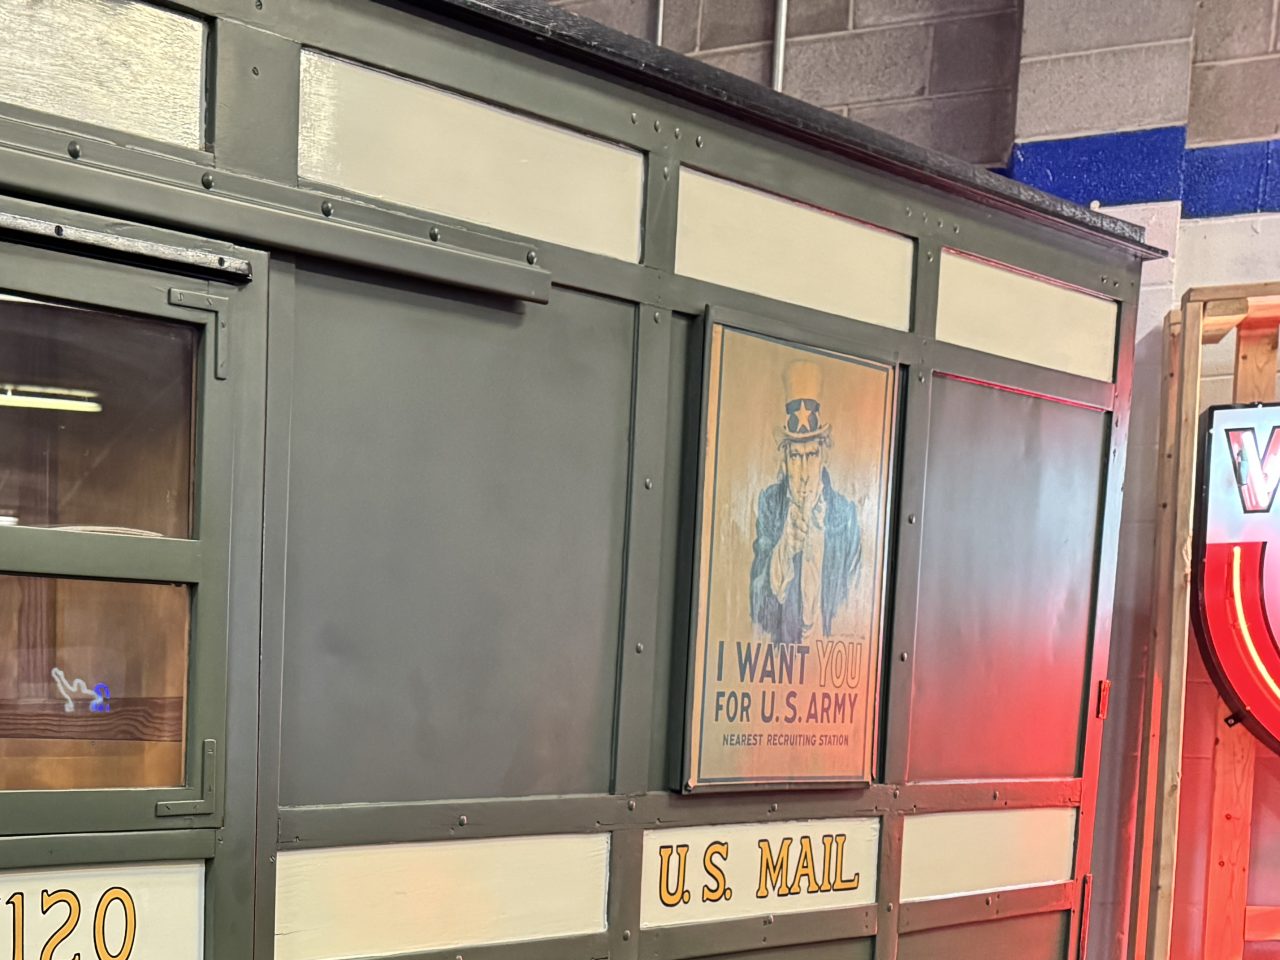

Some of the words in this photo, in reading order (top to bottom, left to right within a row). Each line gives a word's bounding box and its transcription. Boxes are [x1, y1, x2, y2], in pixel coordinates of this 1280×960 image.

[716, 640, 725, 682] I
[736, 640, 810, 685] WANT
[816, 639, 863, 688] YOU
[714, 690, 752, 723] FOR
[806, 691, 858, 724] ARMY
[722, 733, 763, 746] NEAREST
[766, 734, 817, 746] RECRUITING
[818, 734, 849, 746] STATION
[756, 833, 860, 898] MAIL
